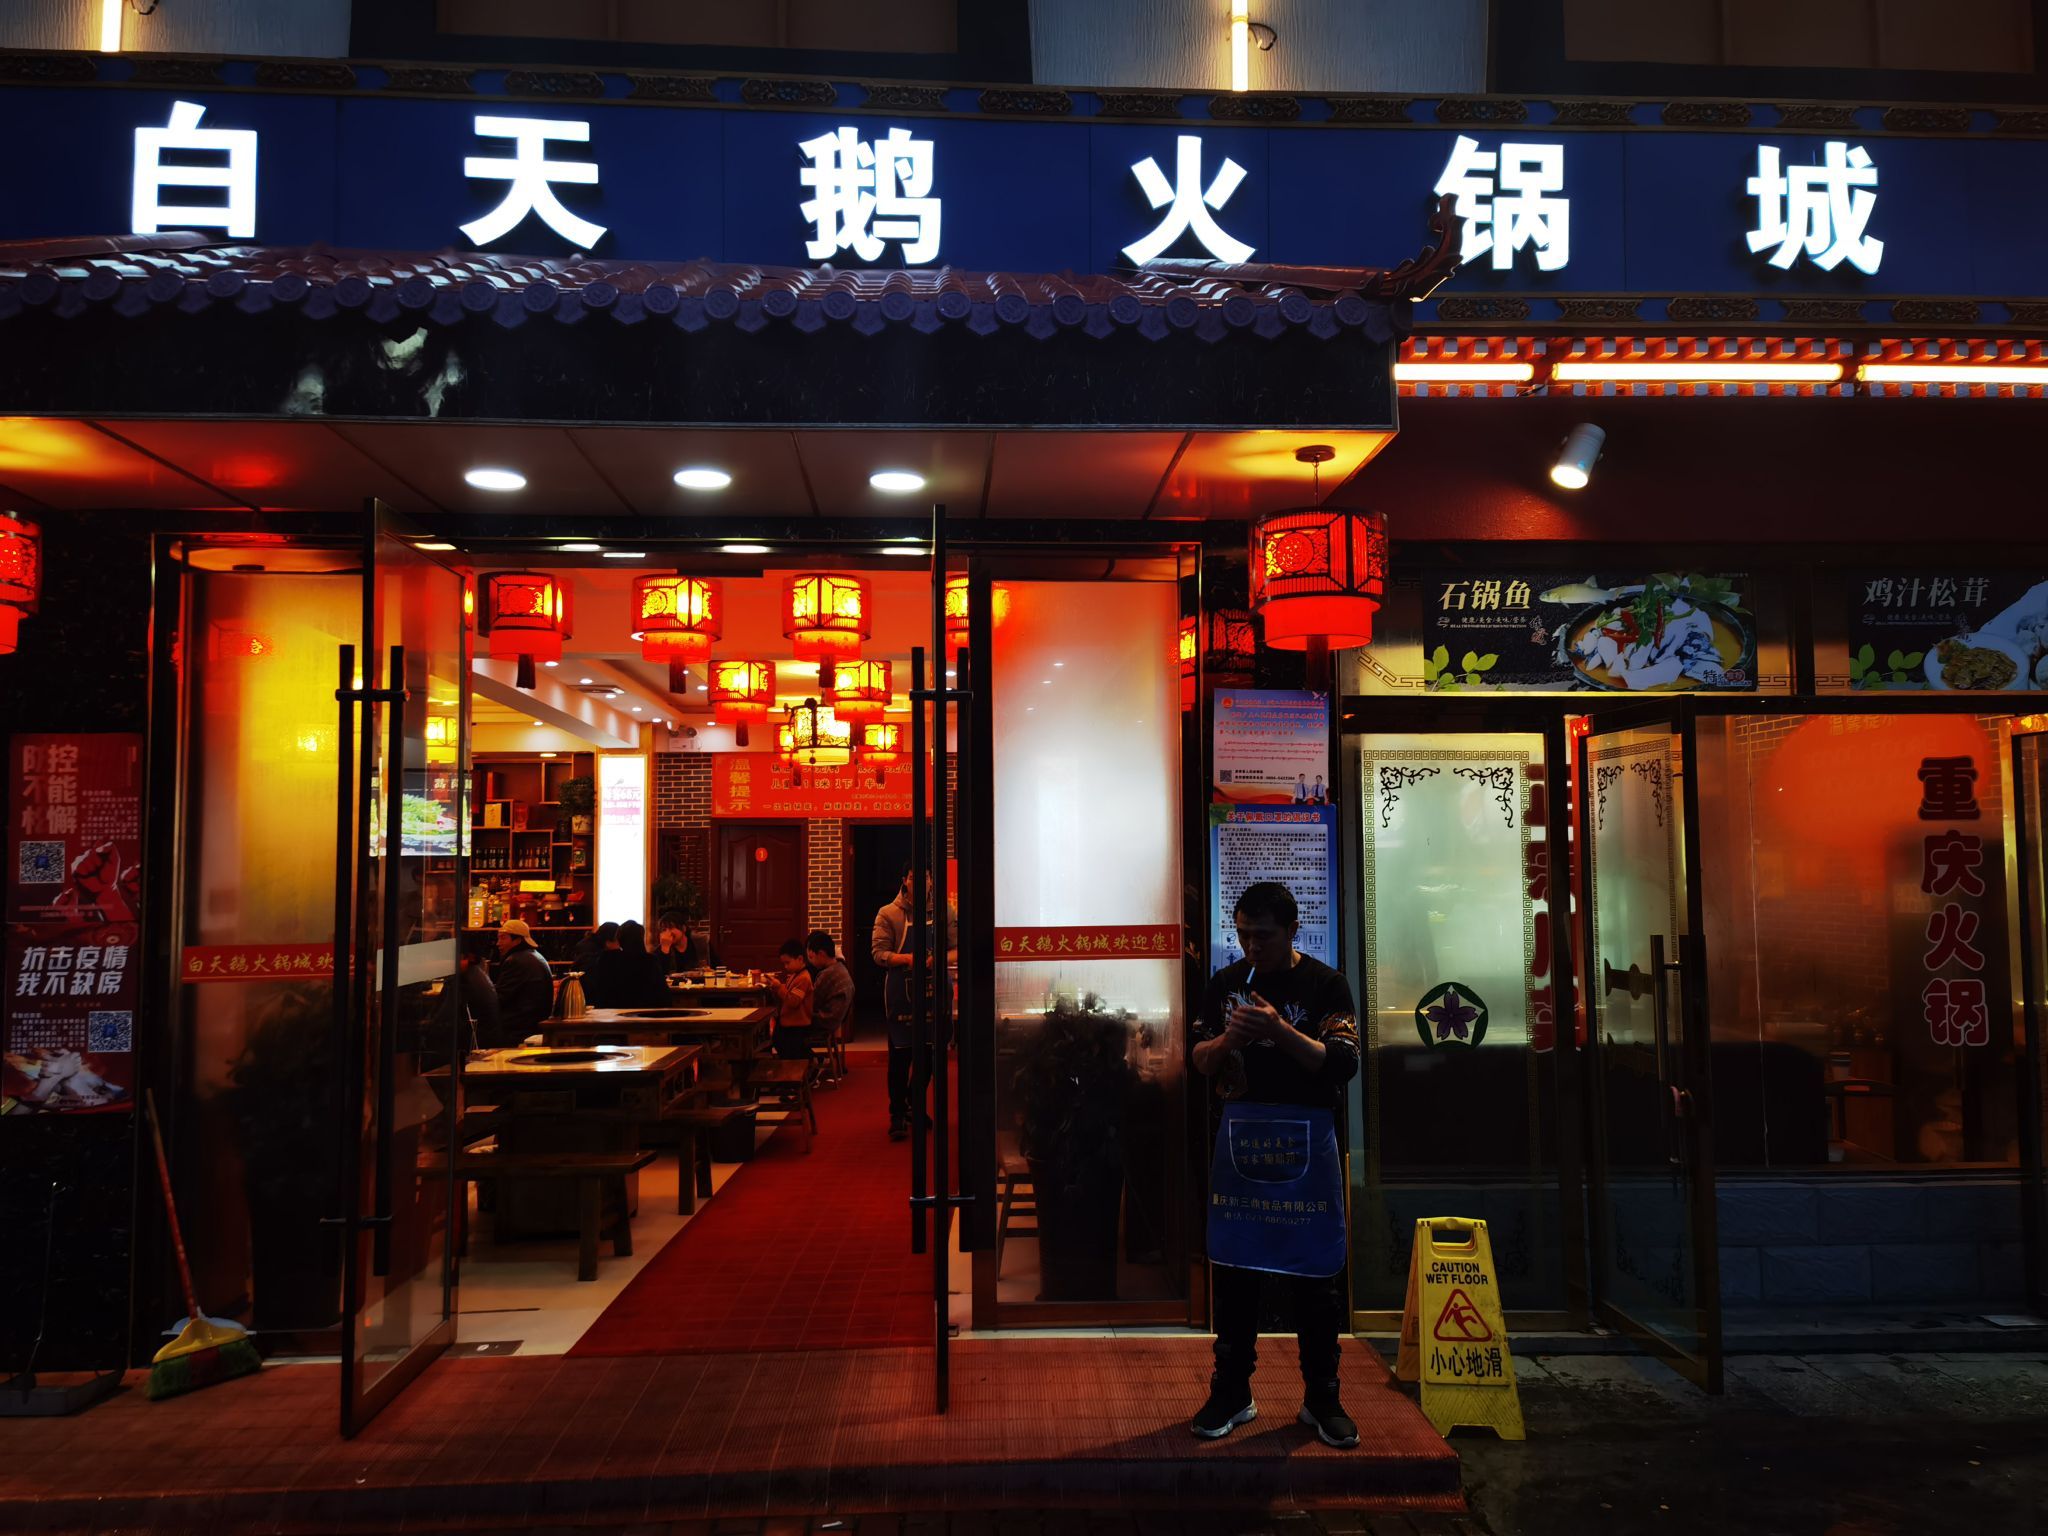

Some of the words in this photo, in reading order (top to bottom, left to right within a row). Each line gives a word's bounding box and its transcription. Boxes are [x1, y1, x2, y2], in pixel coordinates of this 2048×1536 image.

[131, 101, 1885, 276] 白天鹅火锅城
[1438, 580, 1531, 610] 石锅鱼
[1862, 577, 1992, 608] 鸡汁松茸
[728, 758, 752, 812] 温馨提示
[1226, 811, 1320, 823] 关于佩戴口罩的倡议书
[1917, 754, 1989, 1048] 重庆火锅
[999, 931, 1176, 953] 白天鹅火锅城欢迎您!
[20, 945, 130, 972] 抗击疫情
[15, 971, 124, 997] 我不缺席
[1426, 1274, 1450, 1285] WET
[1452, 1274, 1489, 1285] FLOOR
[1432, 1262, 1480, 1273] CAUTION
[1431, 1346, 1503, 1378] 小心地滑
